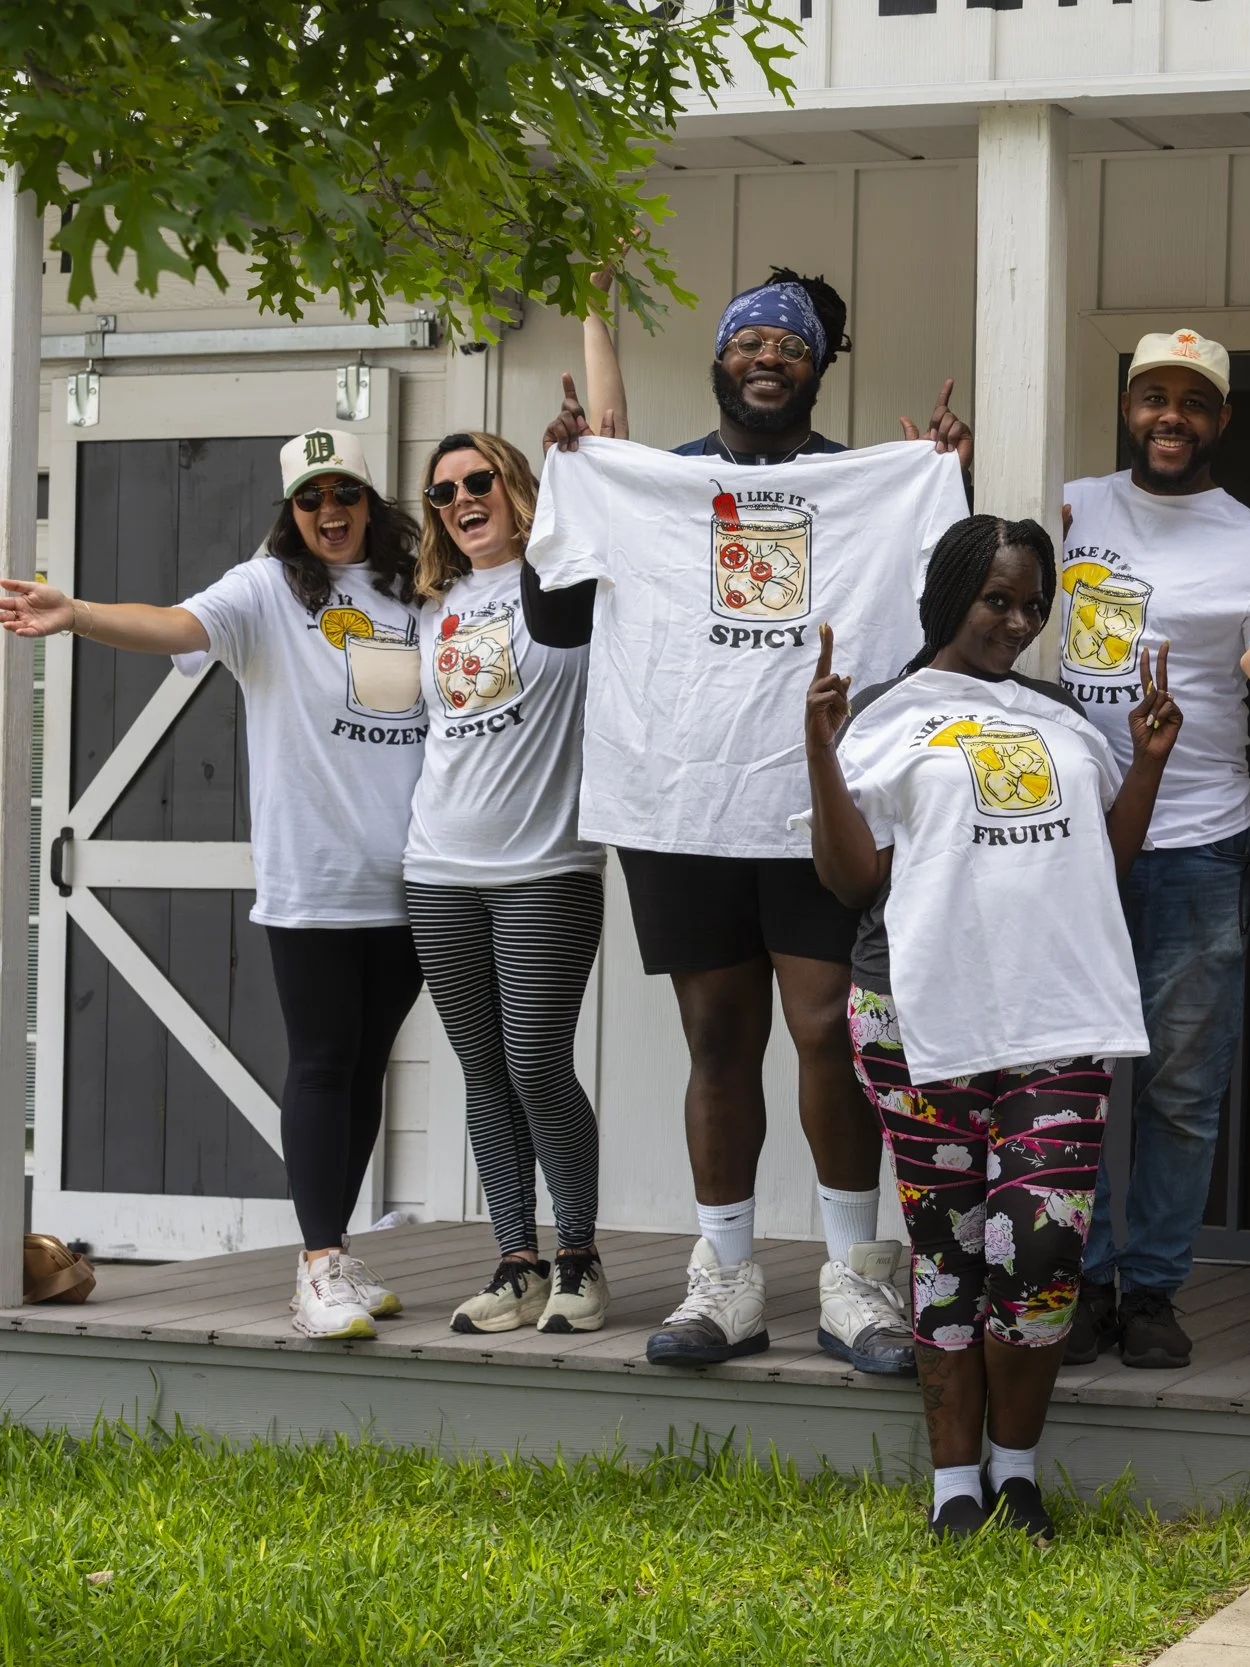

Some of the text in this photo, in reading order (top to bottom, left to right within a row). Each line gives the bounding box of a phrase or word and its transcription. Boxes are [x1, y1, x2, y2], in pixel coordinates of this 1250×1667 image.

[736, 491, 806, 508] I LIKE IT
[1101, 549, 1121, 564] IT
[708, 624, 808, 650] SPICY
[330, 718, 431, 746] FROZEN
[972, 818, 1070, 846] FRUITY
